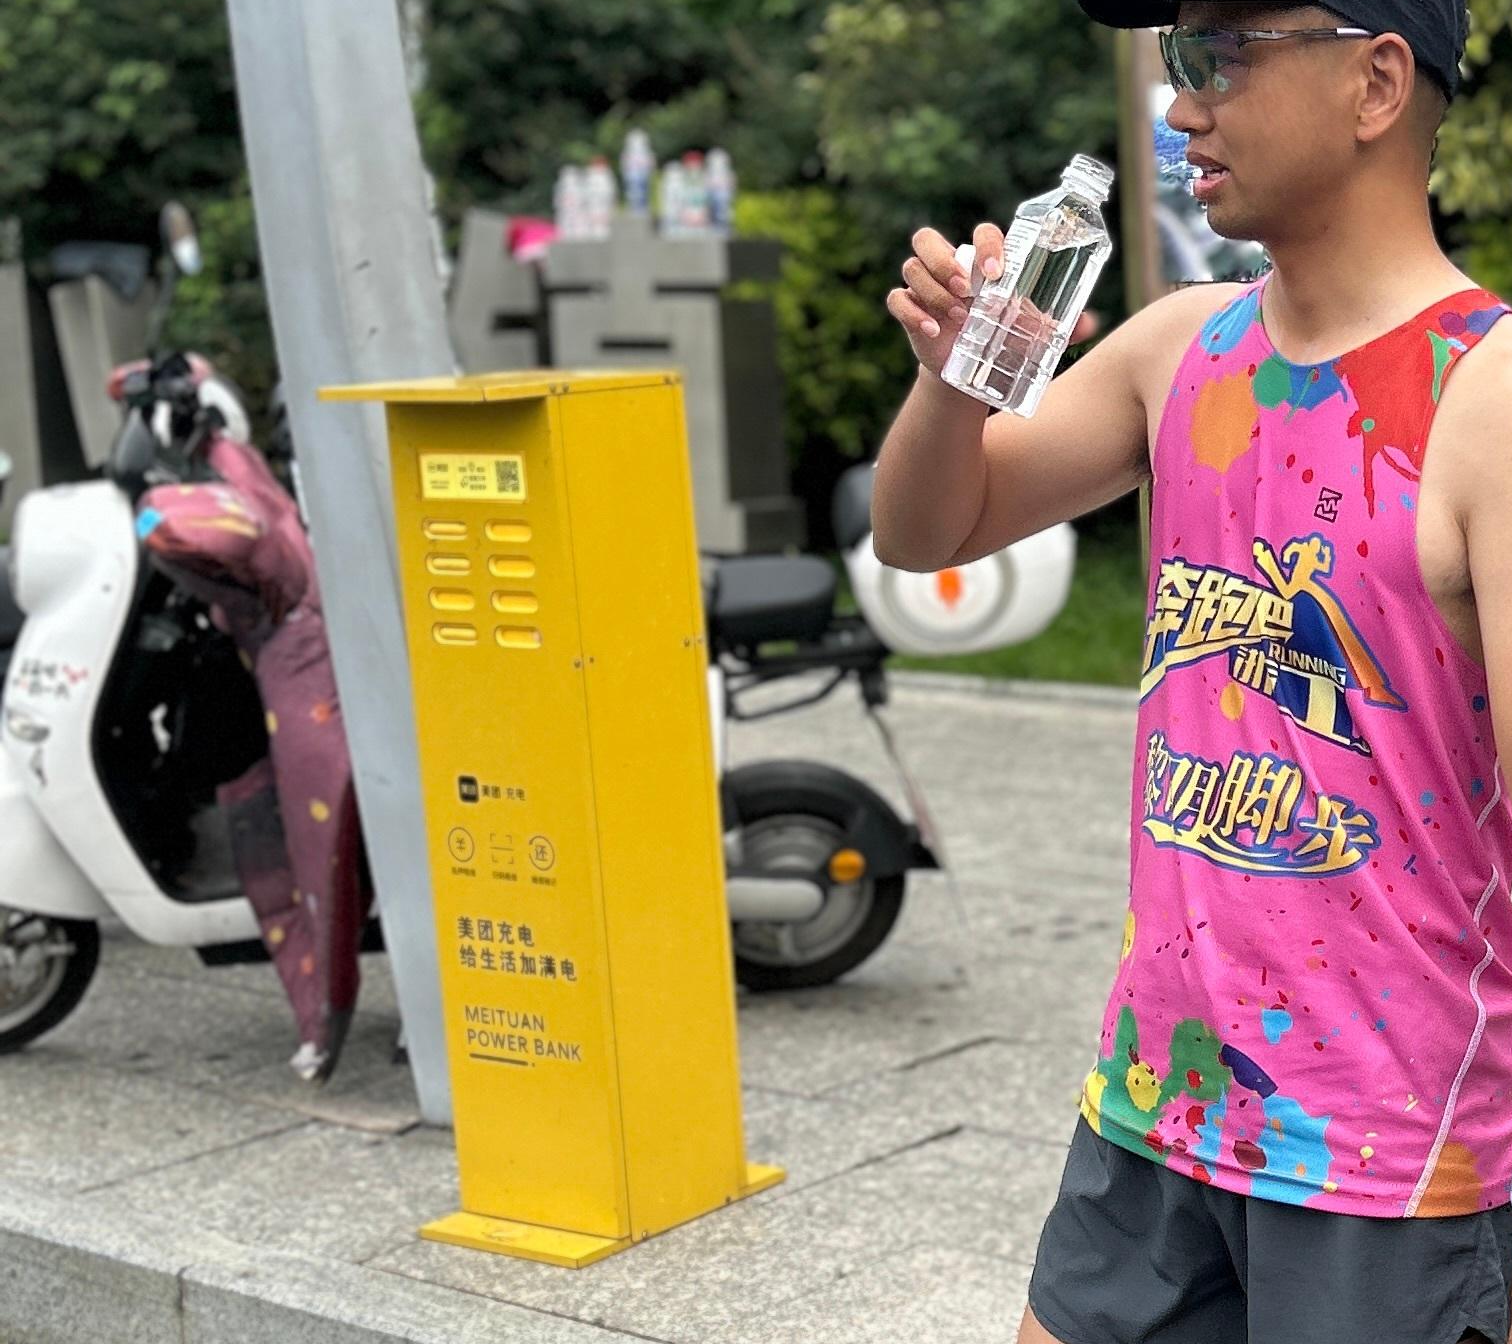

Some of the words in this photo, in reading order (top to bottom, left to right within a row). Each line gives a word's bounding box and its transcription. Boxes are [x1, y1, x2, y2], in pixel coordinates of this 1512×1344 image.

[1142, 560, 1295, 674] 奔跑吧
[1269, 642, 1347, 686] RUNNING
[457, 916, 535, 947] 美团充电
[459, 944, 577, 982] 给生活加满电
[465, 1005, 545, 1032] MEITUAN
[467, 1028, 528, 1053] POWER
[534, 1038, 581, 1062] BANK
